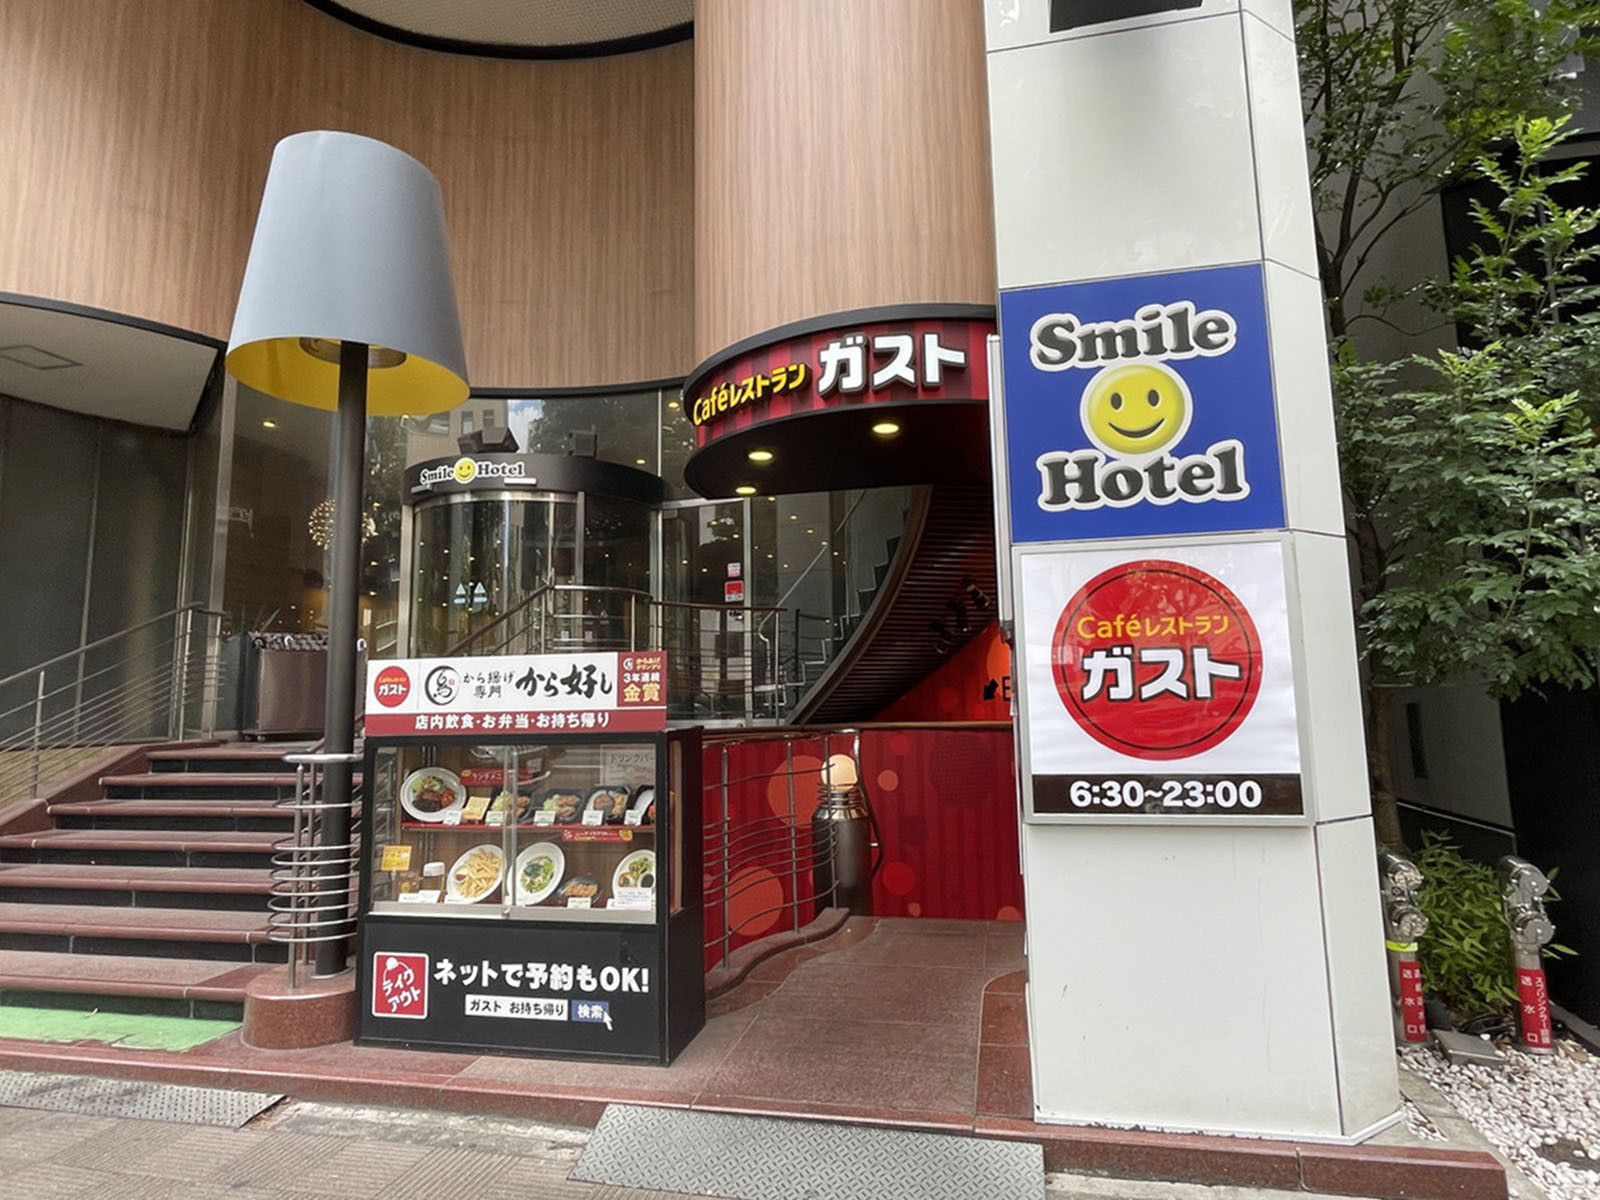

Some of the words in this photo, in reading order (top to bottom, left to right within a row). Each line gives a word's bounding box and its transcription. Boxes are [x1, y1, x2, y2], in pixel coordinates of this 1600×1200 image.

[1034, 304, 1232, 368] Smile
[693, 364, 806, 425] Caféレストラン
[817, 333, 967, 394] ガスト
[420, 465, 455, 484] Smile
[477, 462, 525, 478] Hotel
[1041, 445, 1244, 505] Hotel
[1077, 614, 1230, 639] Caféレストラン
[515, 664, 613, 699] から好し
[1081, 645, 1243, 701] ガスト
[378, 683, 408, 696] ガスト
[623, 683, 660, 702] 金賞
[382, 968, 415, 997] テイク
[433, 958, 650, 993] ネットで予約もOK!
[387, 986, 421, 1013] アウト
[469, 998, 502, 1012] ガスト
[577, 1003, 605, 1020] 検索
